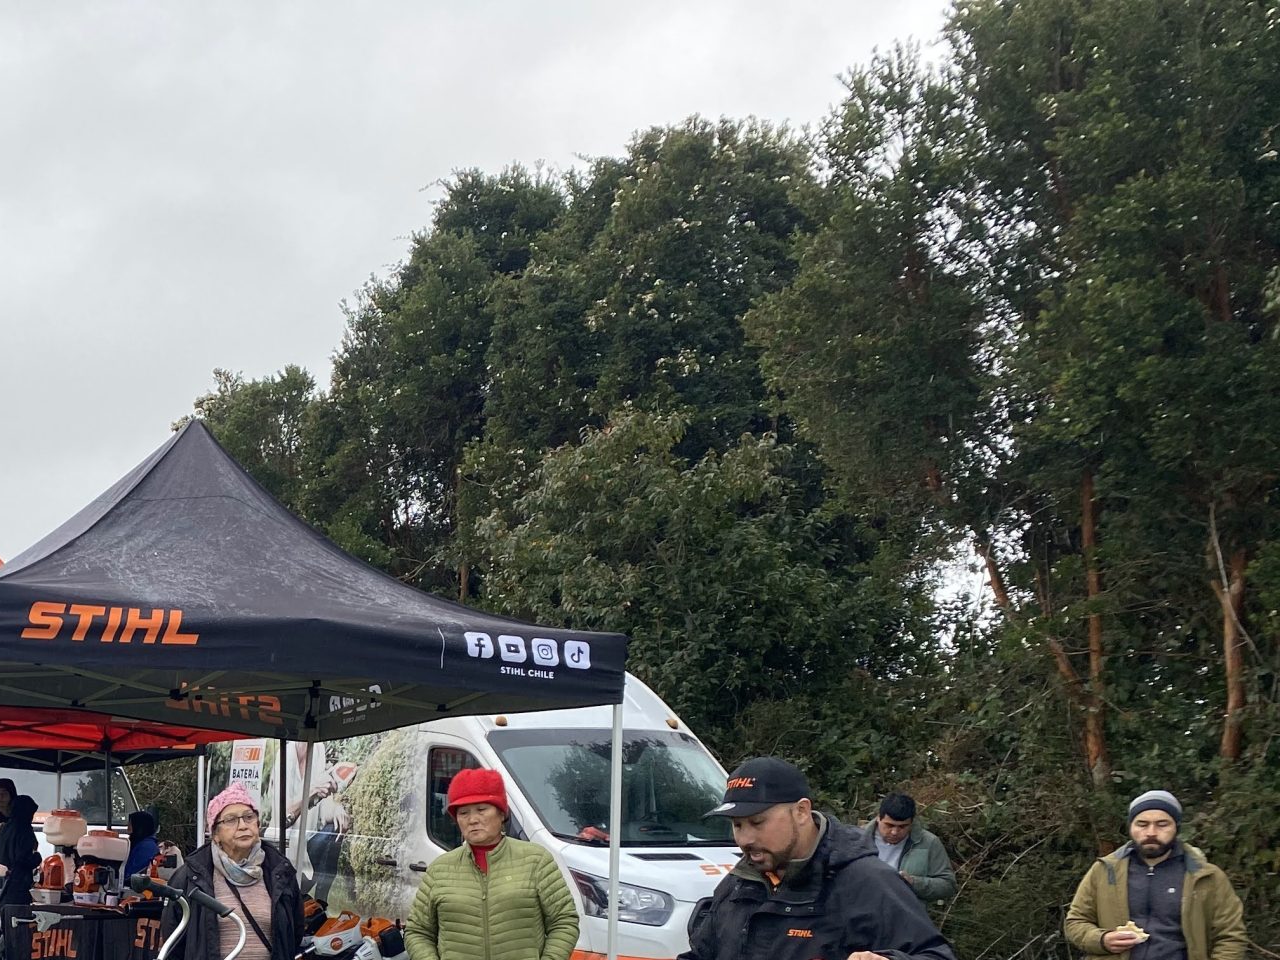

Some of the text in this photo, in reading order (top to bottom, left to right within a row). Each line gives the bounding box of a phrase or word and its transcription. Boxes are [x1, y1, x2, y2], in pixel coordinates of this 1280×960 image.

[20, 601, 200, 645] STIHL
[500, 666, 555, 679] STIHL CHILE
[232, 765, 259, 779] BATERÍA
[700, 864, 734, 876] ST
[786, 928, 813, 938] STIHL
[31, 929, 77, 960] STIHL
